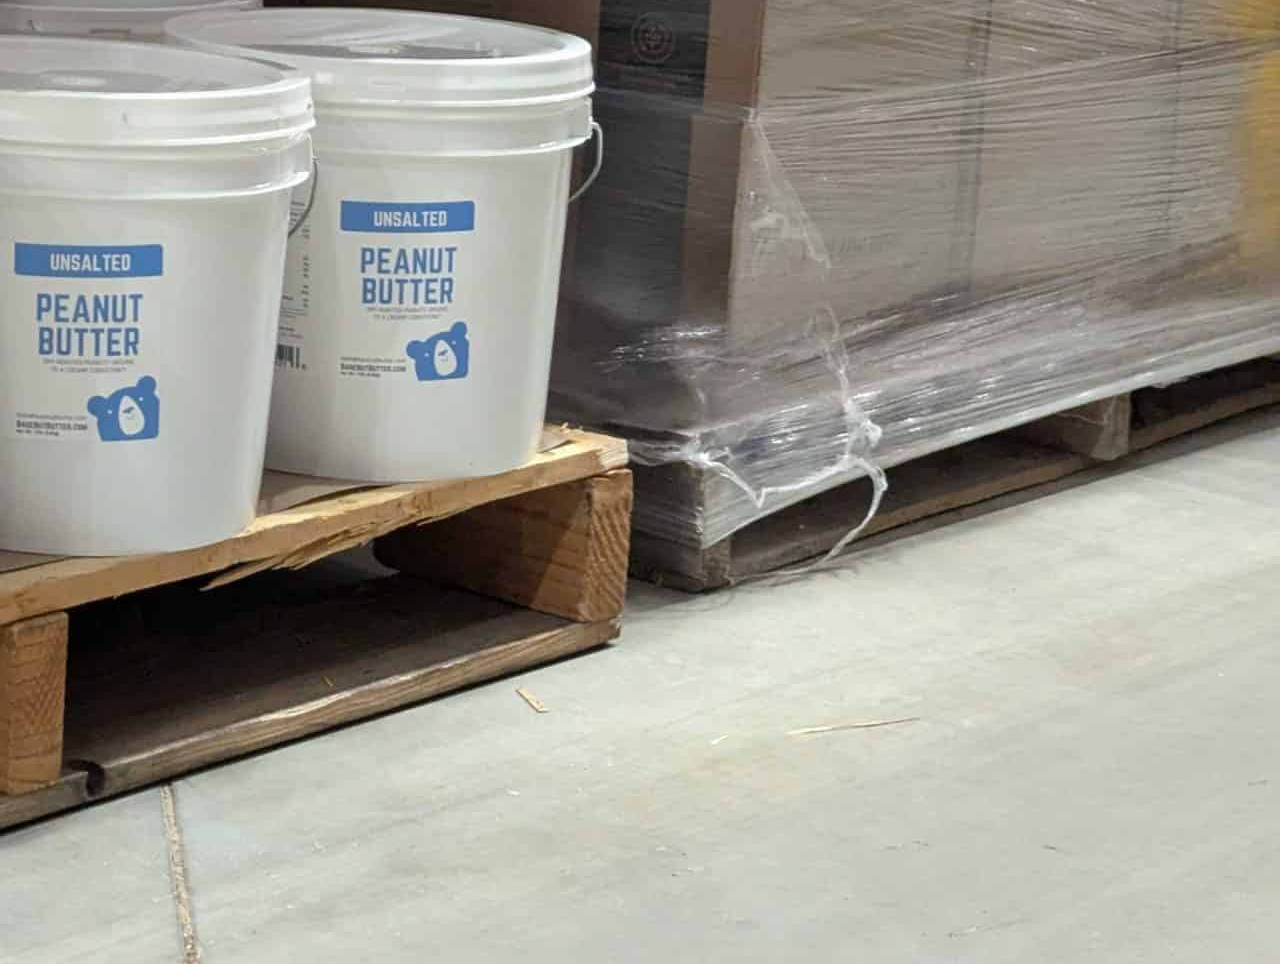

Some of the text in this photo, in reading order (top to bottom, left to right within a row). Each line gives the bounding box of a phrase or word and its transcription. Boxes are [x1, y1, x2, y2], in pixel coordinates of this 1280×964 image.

[374, 210, 448, 227] UNSALTED
[50, 253, 131, 272] UNSALTED
[360, 246, 458, 274] PEANUT
[362, 277, 454, 305] BUTTER
[36, 293, 144, 323] PEANUT
[38, 327, 140, 356] BUTTER
